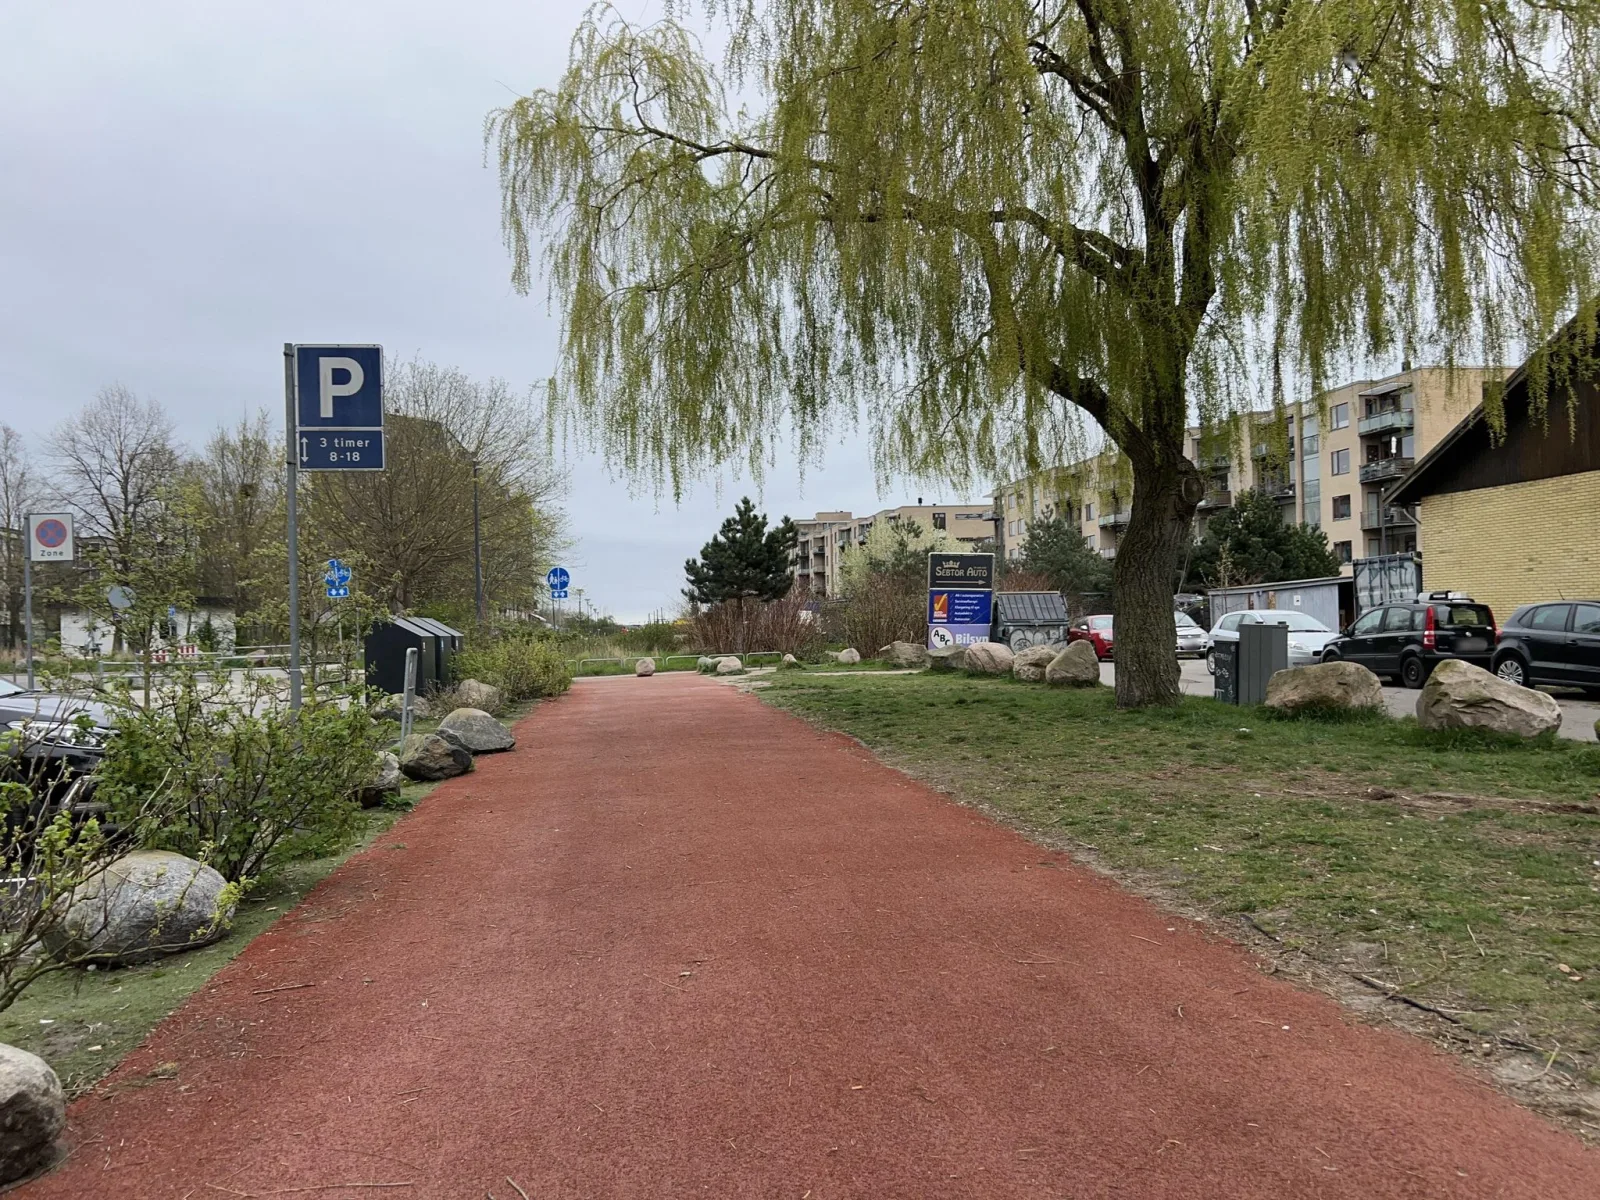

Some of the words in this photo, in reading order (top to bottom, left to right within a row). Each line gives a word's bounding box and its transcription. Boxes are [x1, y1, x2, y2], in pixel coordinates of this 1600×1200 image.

[318, 356, 365, 418] P
[319, 437, 328, 448] 3
[334, 437, 370, 448] timer
[329, 451, 361, 462] 8-18
[40, 549, 65, 557] Zone
[935, 566, 965, 577] SEBTOR
[966, 566, 988, 577] AUTO
